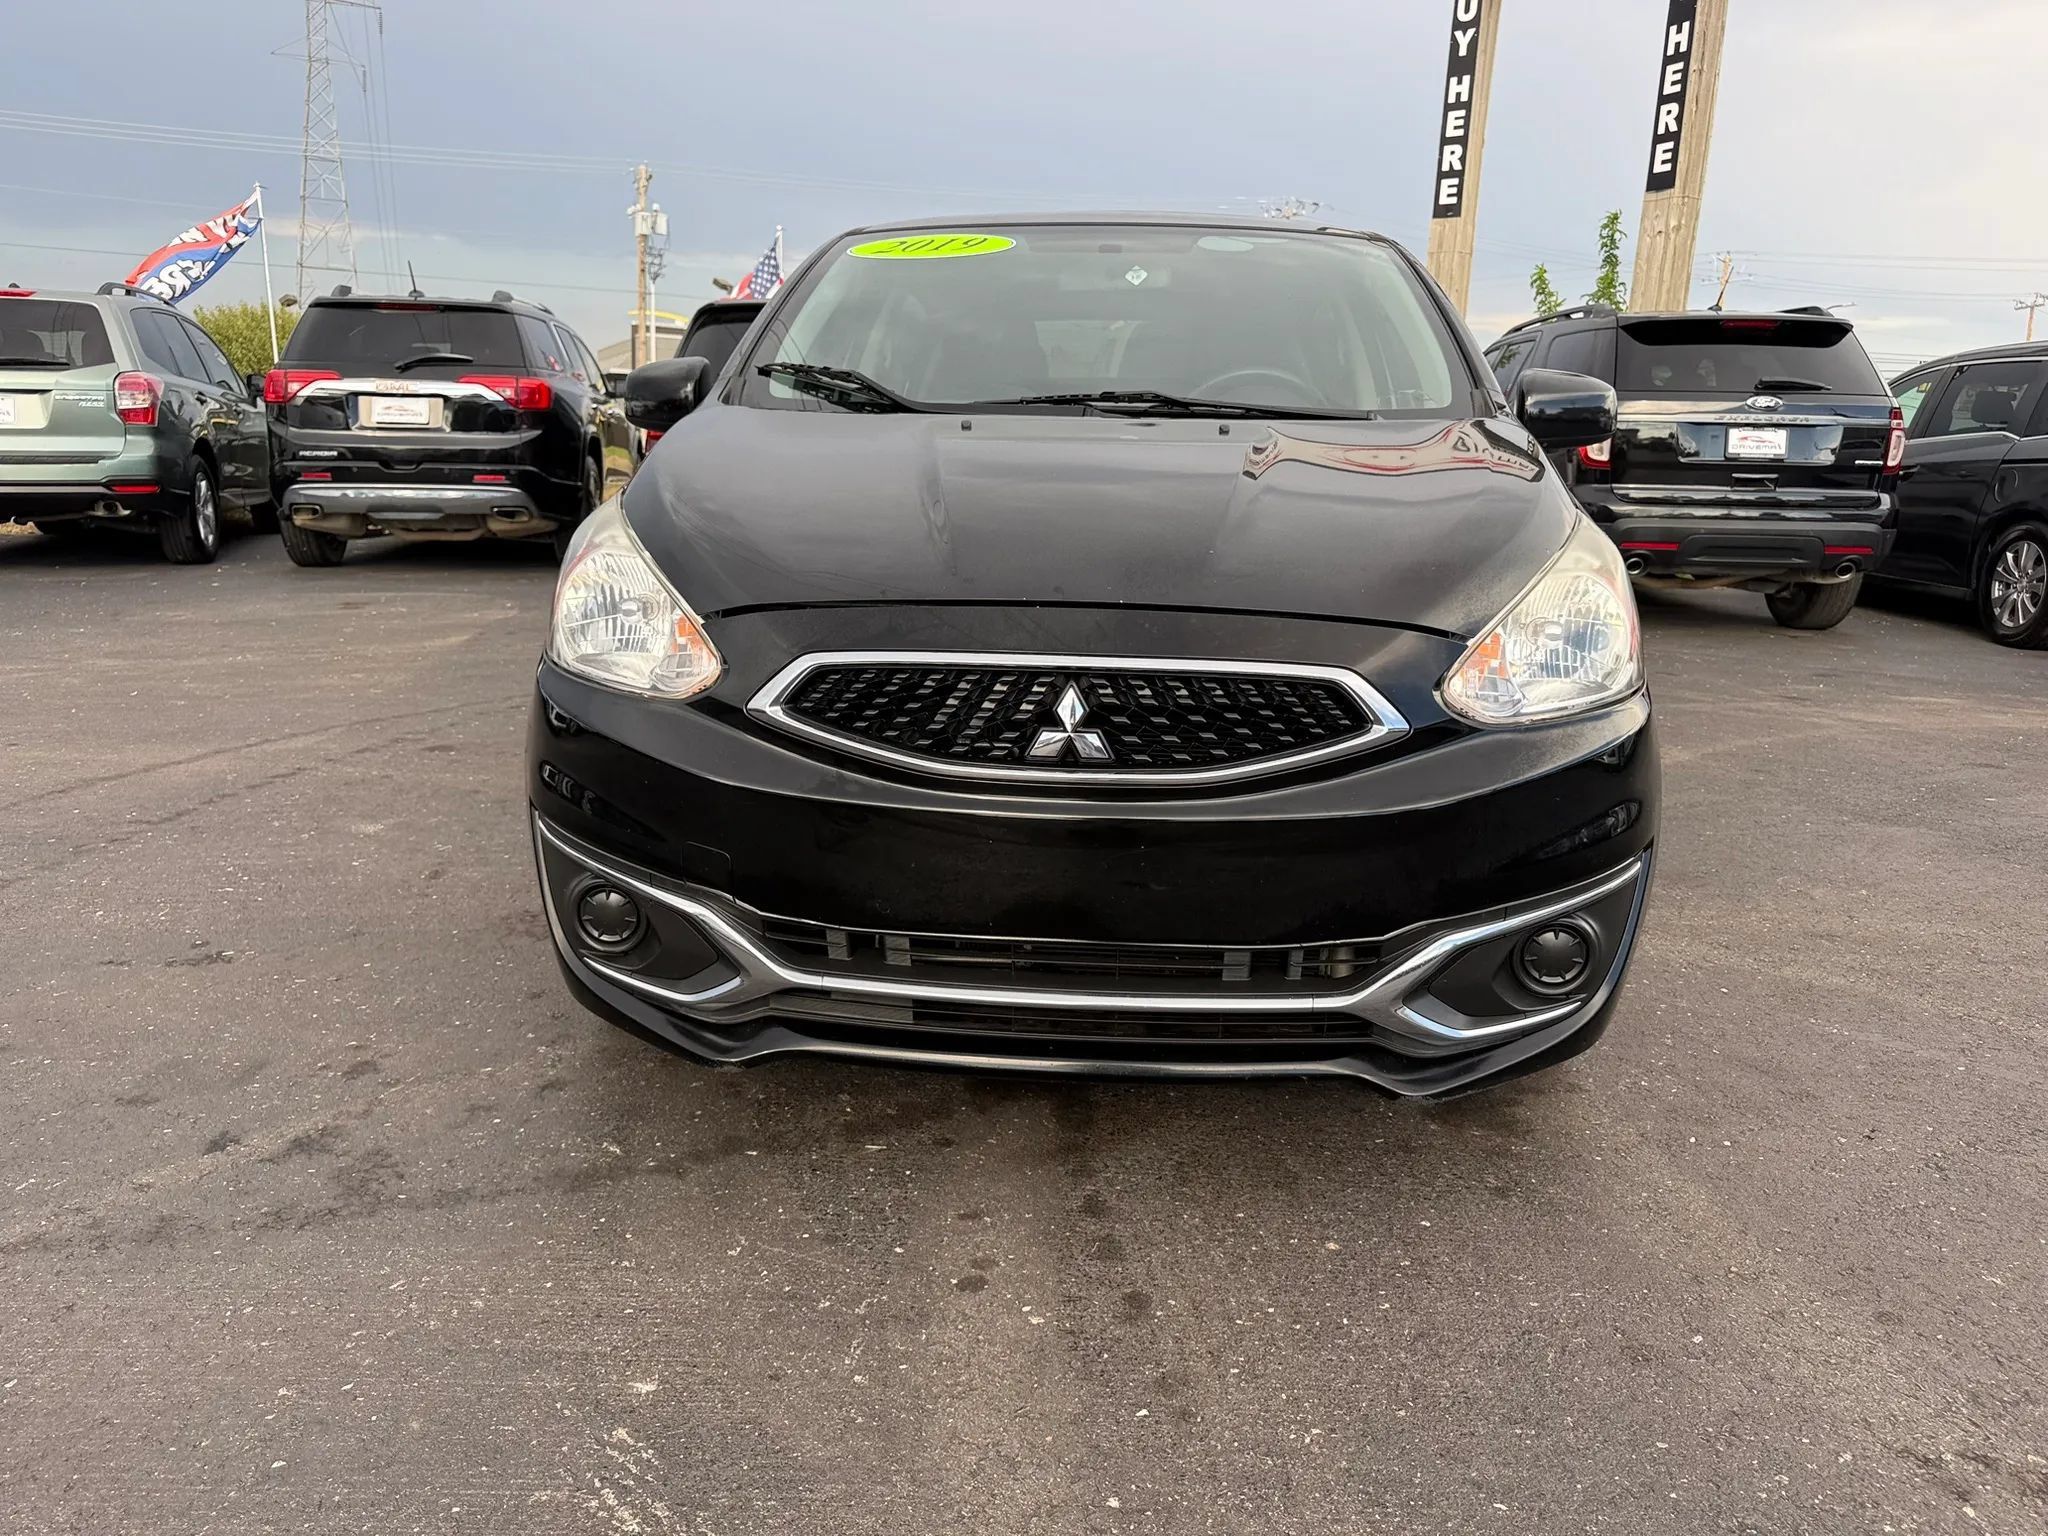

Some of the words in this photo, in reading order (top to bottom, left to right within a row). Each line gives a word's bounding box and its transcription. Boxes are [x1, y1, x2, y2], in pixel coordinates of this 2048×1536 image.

[1438, 74, 1471, 205] HERE
[1652, 20, 1690, 174] HERE
[870, 237, 988, 254] 2019
